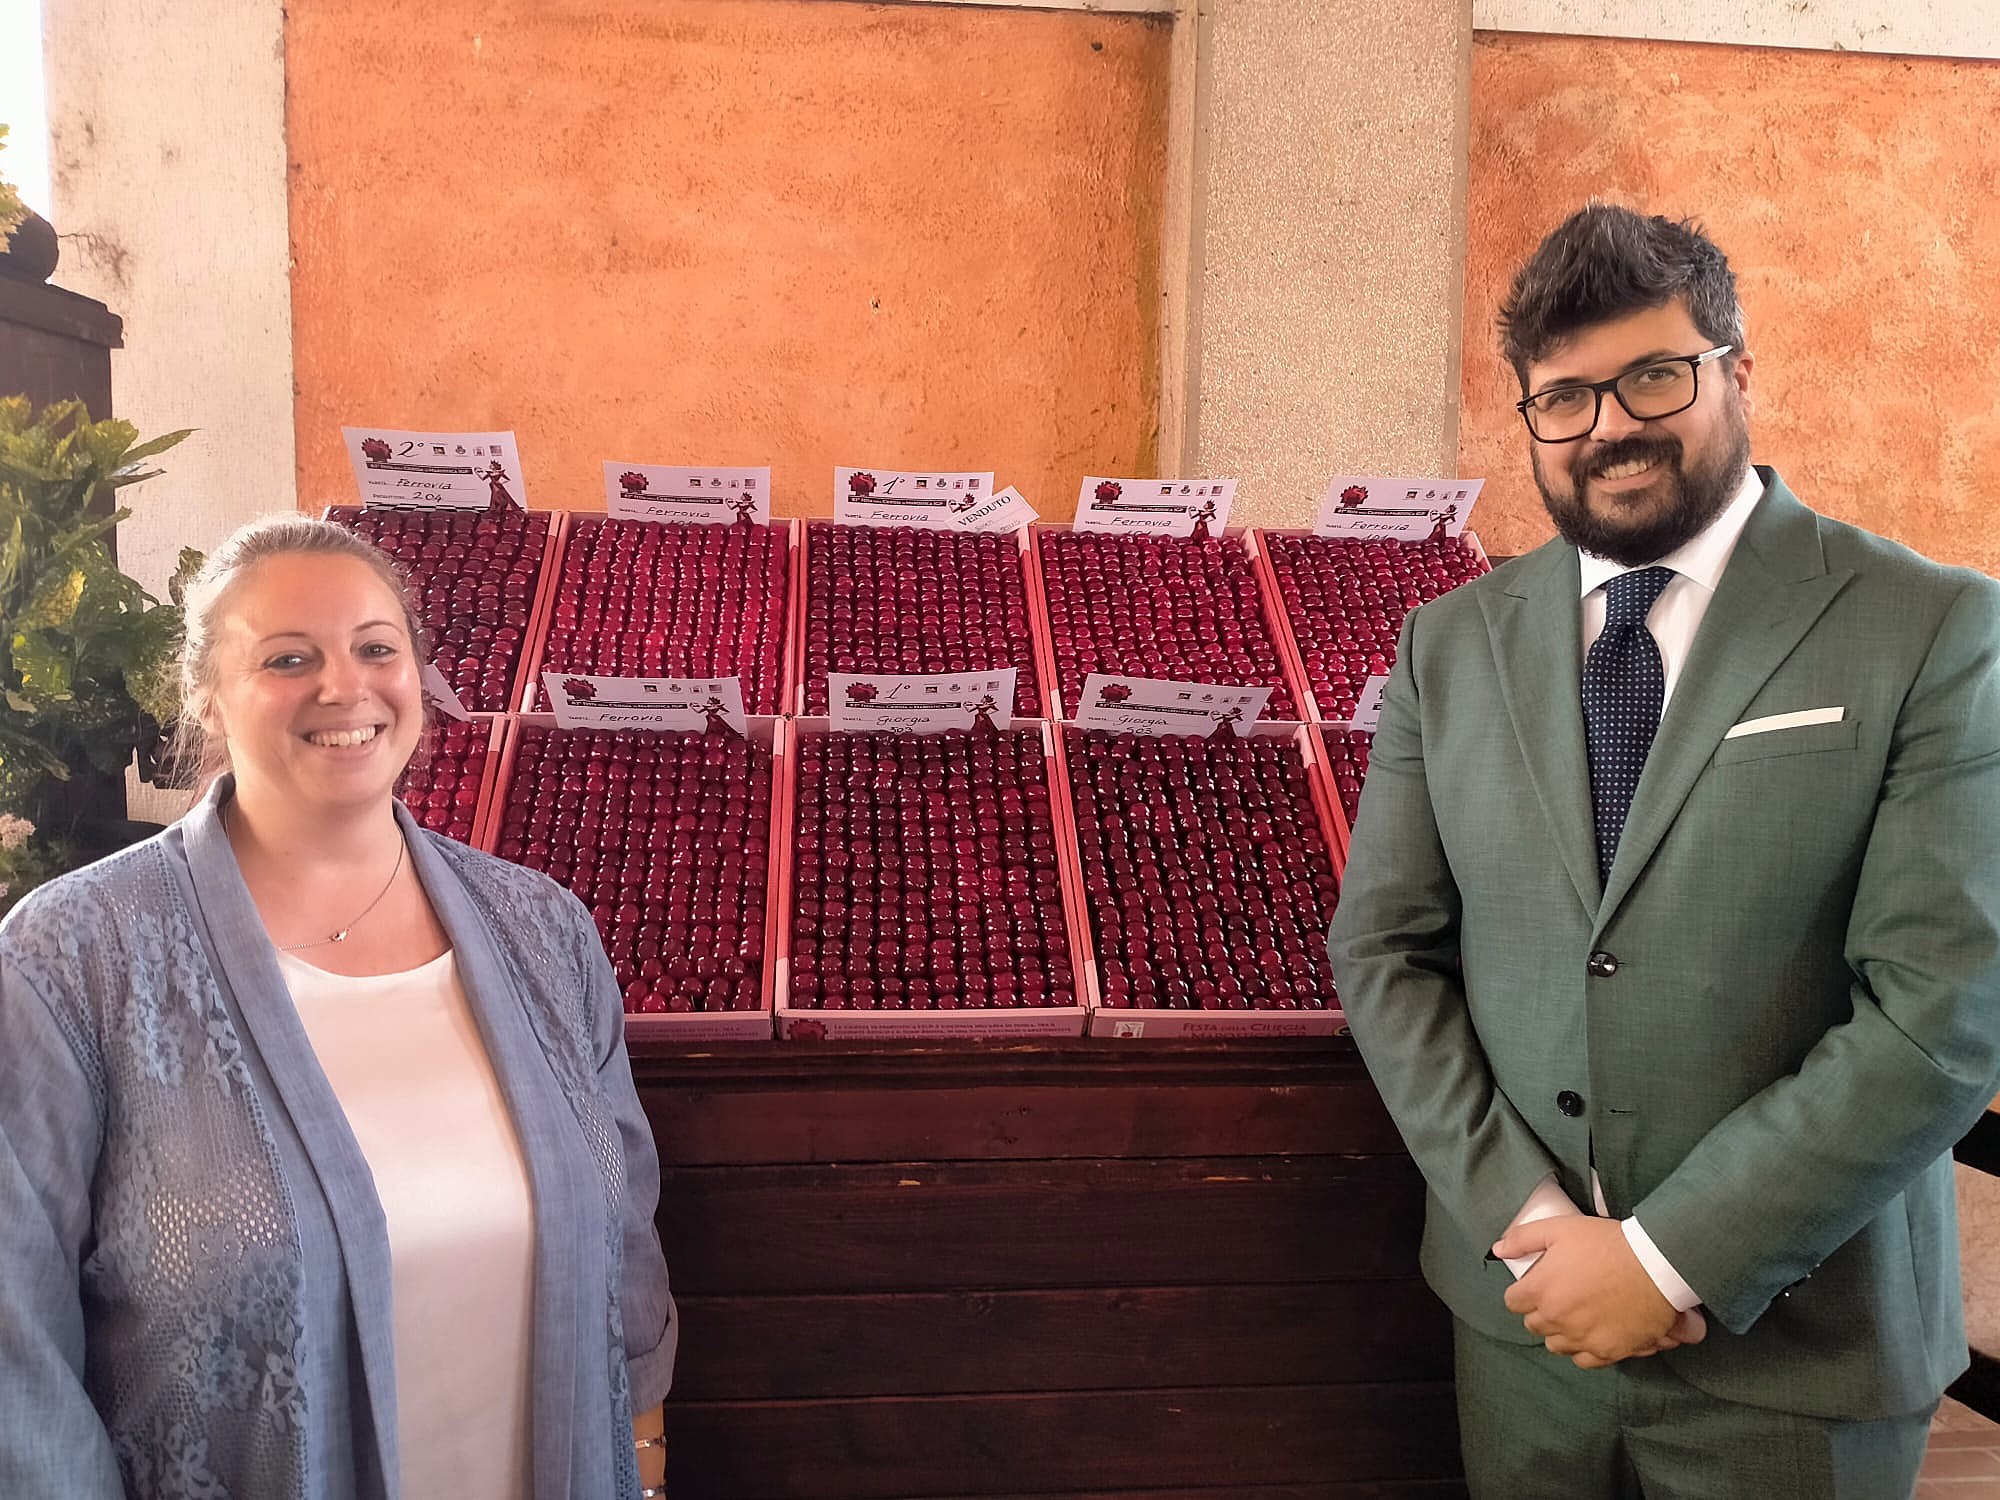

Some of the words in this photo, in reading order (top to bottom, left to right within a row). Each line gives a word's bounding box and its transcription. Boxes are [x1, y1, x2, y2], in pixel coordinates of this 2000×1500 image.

[397, 479, 452, 489] Ferrovia
[646, 506, 710, 517] Ferrovia
[871, 510, 929, 521] Ferrovia
[957, 495, 1011, 526] VENDUTO
[1111, 516, 1172, 526] Ferrovia
[1350, 520, 1409, 530] Ferrovia
[600, 713, 663, 721] Ferrovia
[1118, 714, 1168, 727] Giorgia
[1182, 1022, 1217, 1032] FESTA
